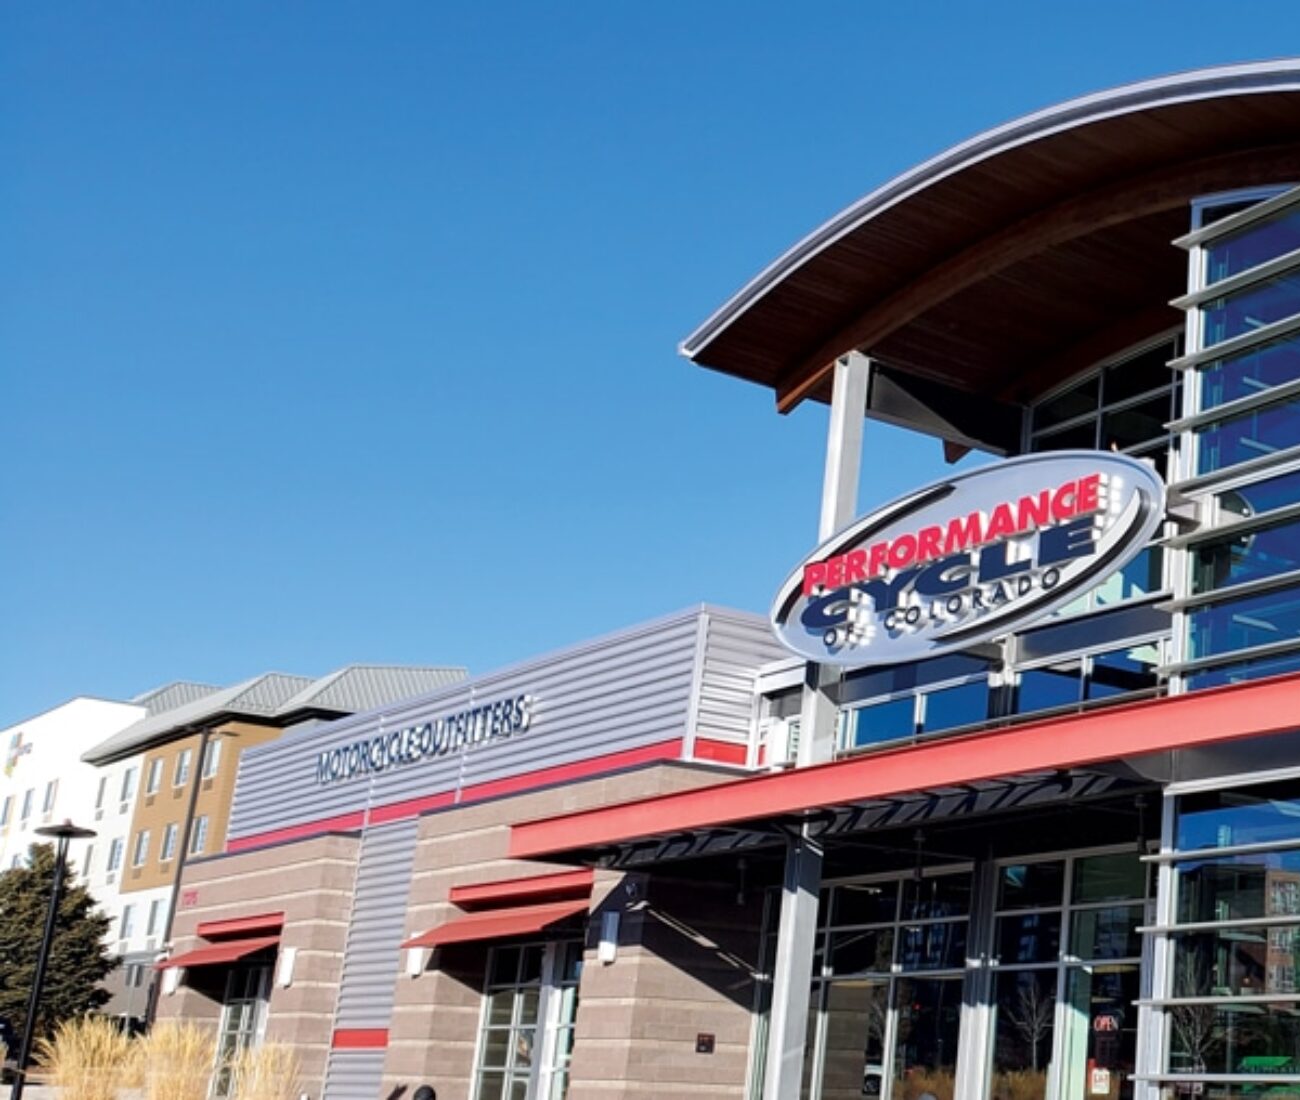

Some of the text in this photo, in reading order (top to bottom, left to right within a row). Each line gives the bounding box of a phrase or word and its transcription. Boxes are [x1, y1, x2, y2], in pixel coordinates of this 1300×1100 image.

[801, 515, 1097, 628] CYCLE
[802, 473, 1101, 597] PERFORMANCE
[823, 567, 1061, 647] OF COLORADO
[316, 694, 526, 784] MOTORCYCLE OUTFITTERS
[1093, 1015, 1119, 1032] OPEN
